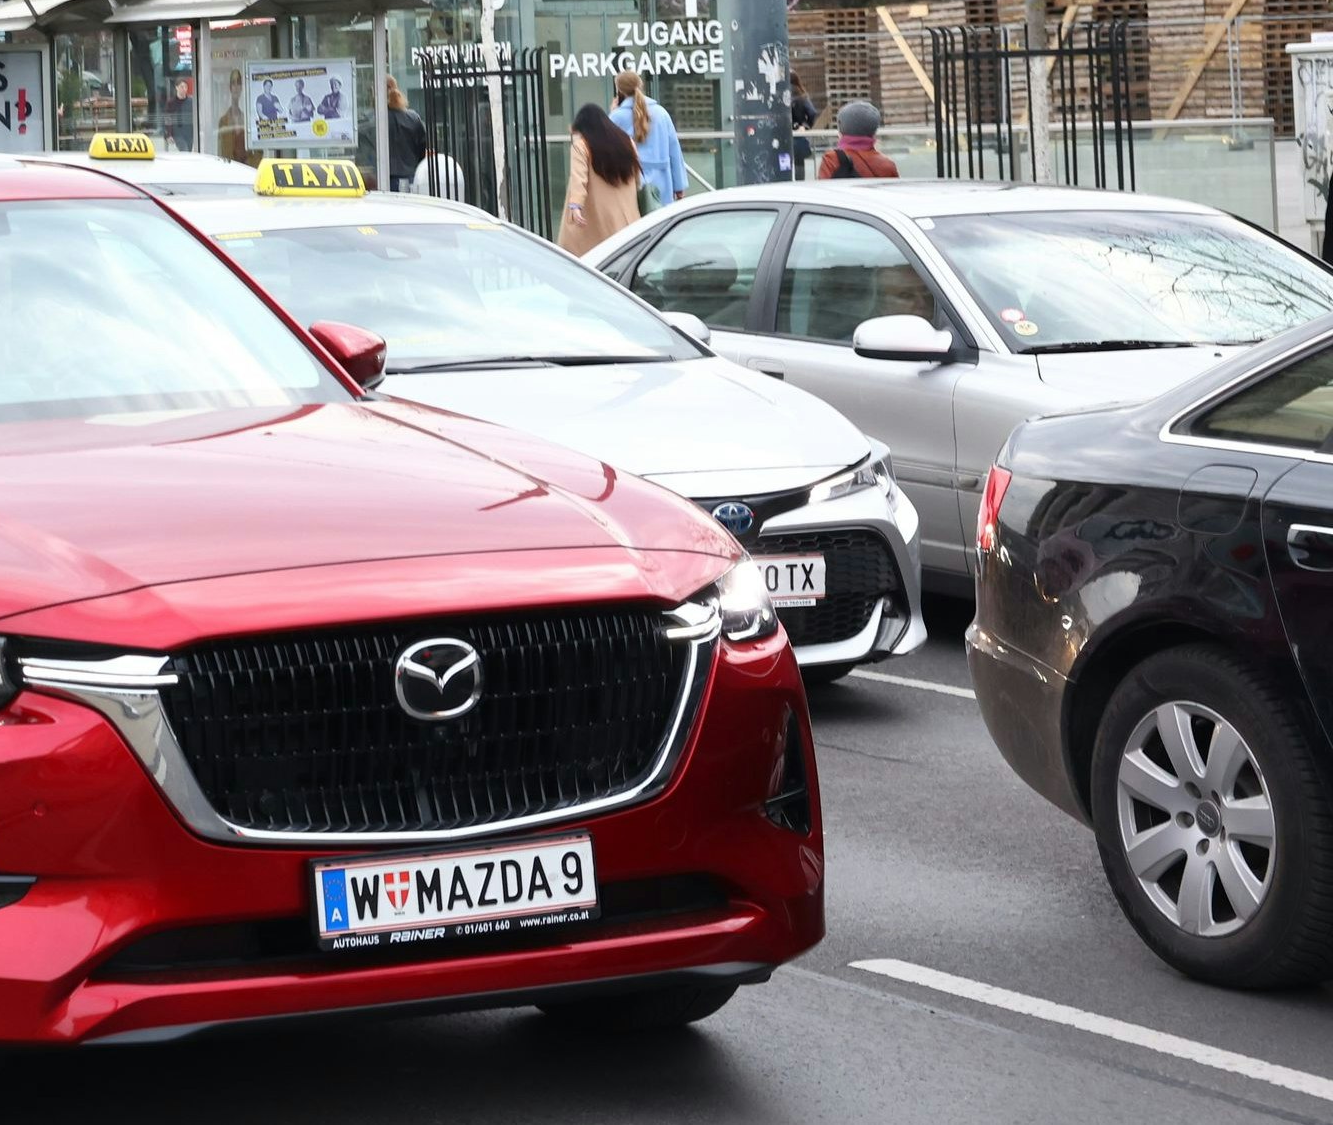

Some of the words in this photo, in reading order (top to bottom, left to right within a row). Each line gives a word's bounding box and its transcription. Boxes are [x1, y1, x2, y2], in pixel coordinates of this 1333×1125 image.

[616, 20, 724, 48] ZUGANG
[549, 49, 725, 79] PARKGARAGE
[106, 138, 149, 153] TAXI
[278, 164, 355, 187] TAXI
[785, 562, 815, 592] TX
[351, 874, 380, 920] W
[415, 855, 553, 914] MAZDA
[561, 851, 584, 895] 9
[331, 908, 343, 923] A
[333, 935, 380, 950] AUTOHAUS
[464, 923, 494, 935] 01/601
[495, 921, 510, 931] 660
[519, 910, 590, 928] www.rainer.co.at
